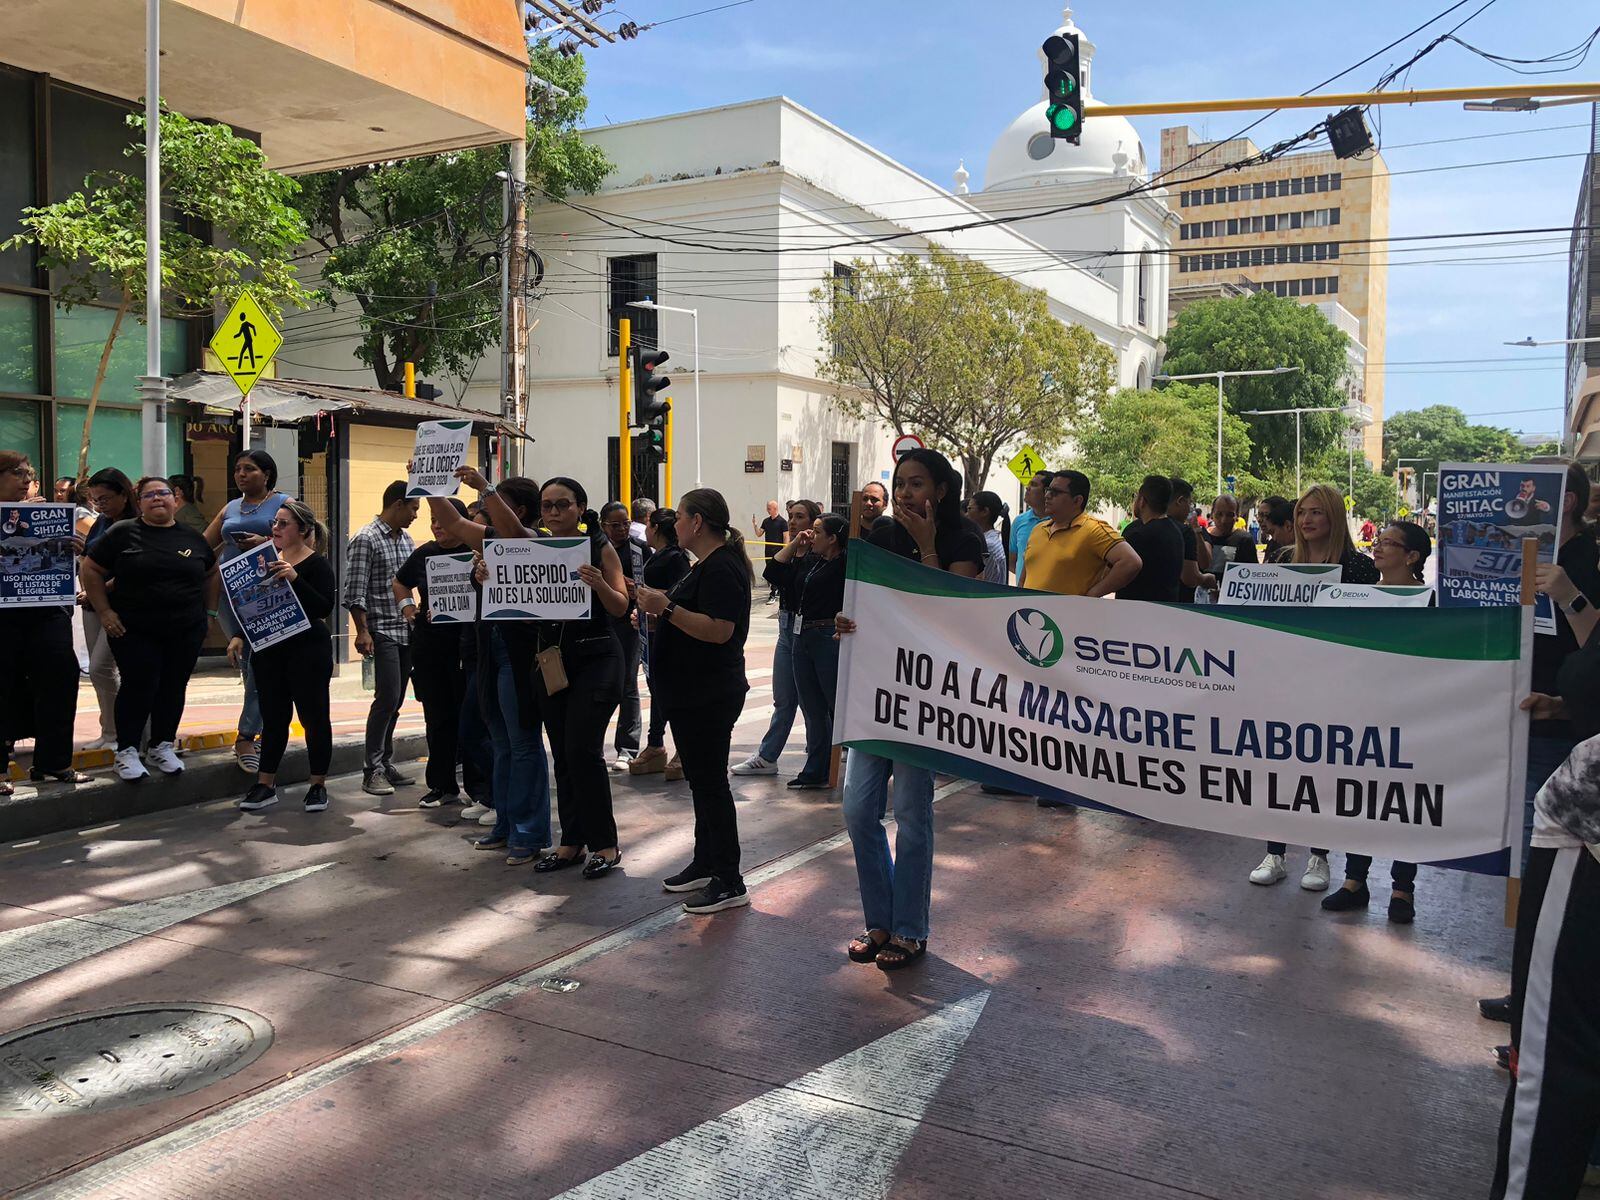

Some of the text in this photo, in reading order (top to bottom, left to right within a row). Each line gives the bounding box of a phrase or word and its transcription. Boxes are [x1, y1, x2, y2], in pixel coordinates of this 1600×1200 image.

[426, 457, 434, 473] LA
[1443, 472, 1500, 490] GRAN
[1443, 487, 1502, 499] MANIFESTACIÓN
[1446, 498, 1503, 514] SIHTAC
[31, 509, 67, 520] GRAN
[34, 524, 70, 535] SIHTAC
[224, 557, 249, 578] GRAN
[497, 564, 567, 585] EL DESPIDO
[230, 570, 256, 590] SIHTAC
[1443, 579, 1460, 588] NO
[1462, 580, 1471, 589] A
[1473, 580, 1488, 590] LA
[17, 587, 58, 595] ELEGIBLES.
[489, 583, 585, 604] NO ES LA SOLUCIÓN
[1227, 580, 1322, 603] DESVINCULACI
[1450, 589, 1520, 603] LABORAL EN
[270, 604, 297, 620] MASACRE
[439, 597, 447, 612] EN
[448, 596, 457, 611] LA
[253, 619, 279, 634] LABORAL
[270, 623, 285, 633] DIAN
[1074, 636, 1235, 678] SEDIAN
[1076, 665, 1235, 692] SINDICATO DE EMPLEADOS DE LA DIAN
[895, 647, 1414, 769] NO A LA MASACRE LABORAL
[874, 688, 1444, 827] DE PROVISIONALES EN LA DIAN
